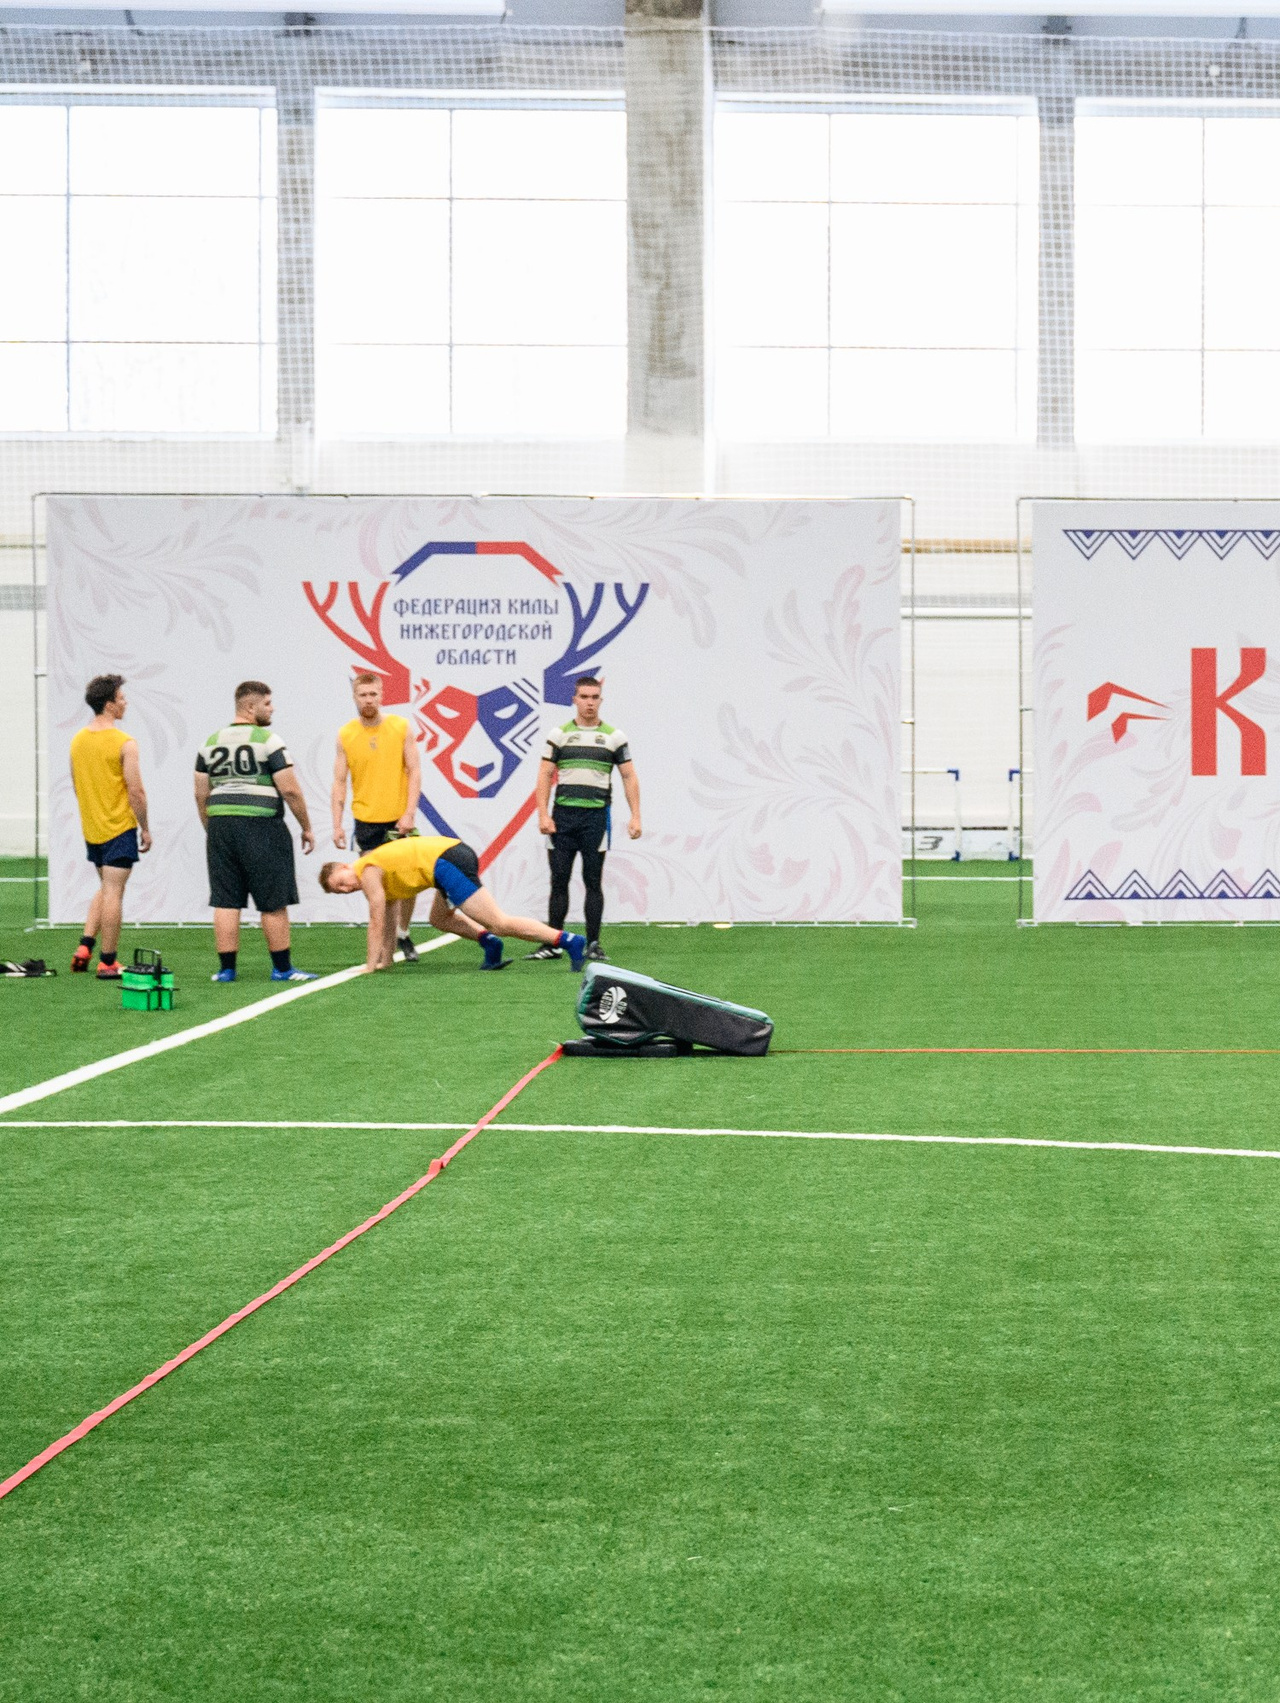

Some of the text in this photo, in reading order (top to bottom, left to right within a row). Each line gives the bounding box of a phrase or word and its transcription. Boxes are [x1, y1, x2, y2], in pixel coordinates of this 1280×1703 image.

[393, 598, 559, 618] ФЕДЕРАЦИЯ КИЛЫ
[400, 621, 553, 641] НИЖЕГОРОДСКОЙ
[436, 649, 517, 665] ОБЛАСТИ
[210, 744, 259, 777] 20
